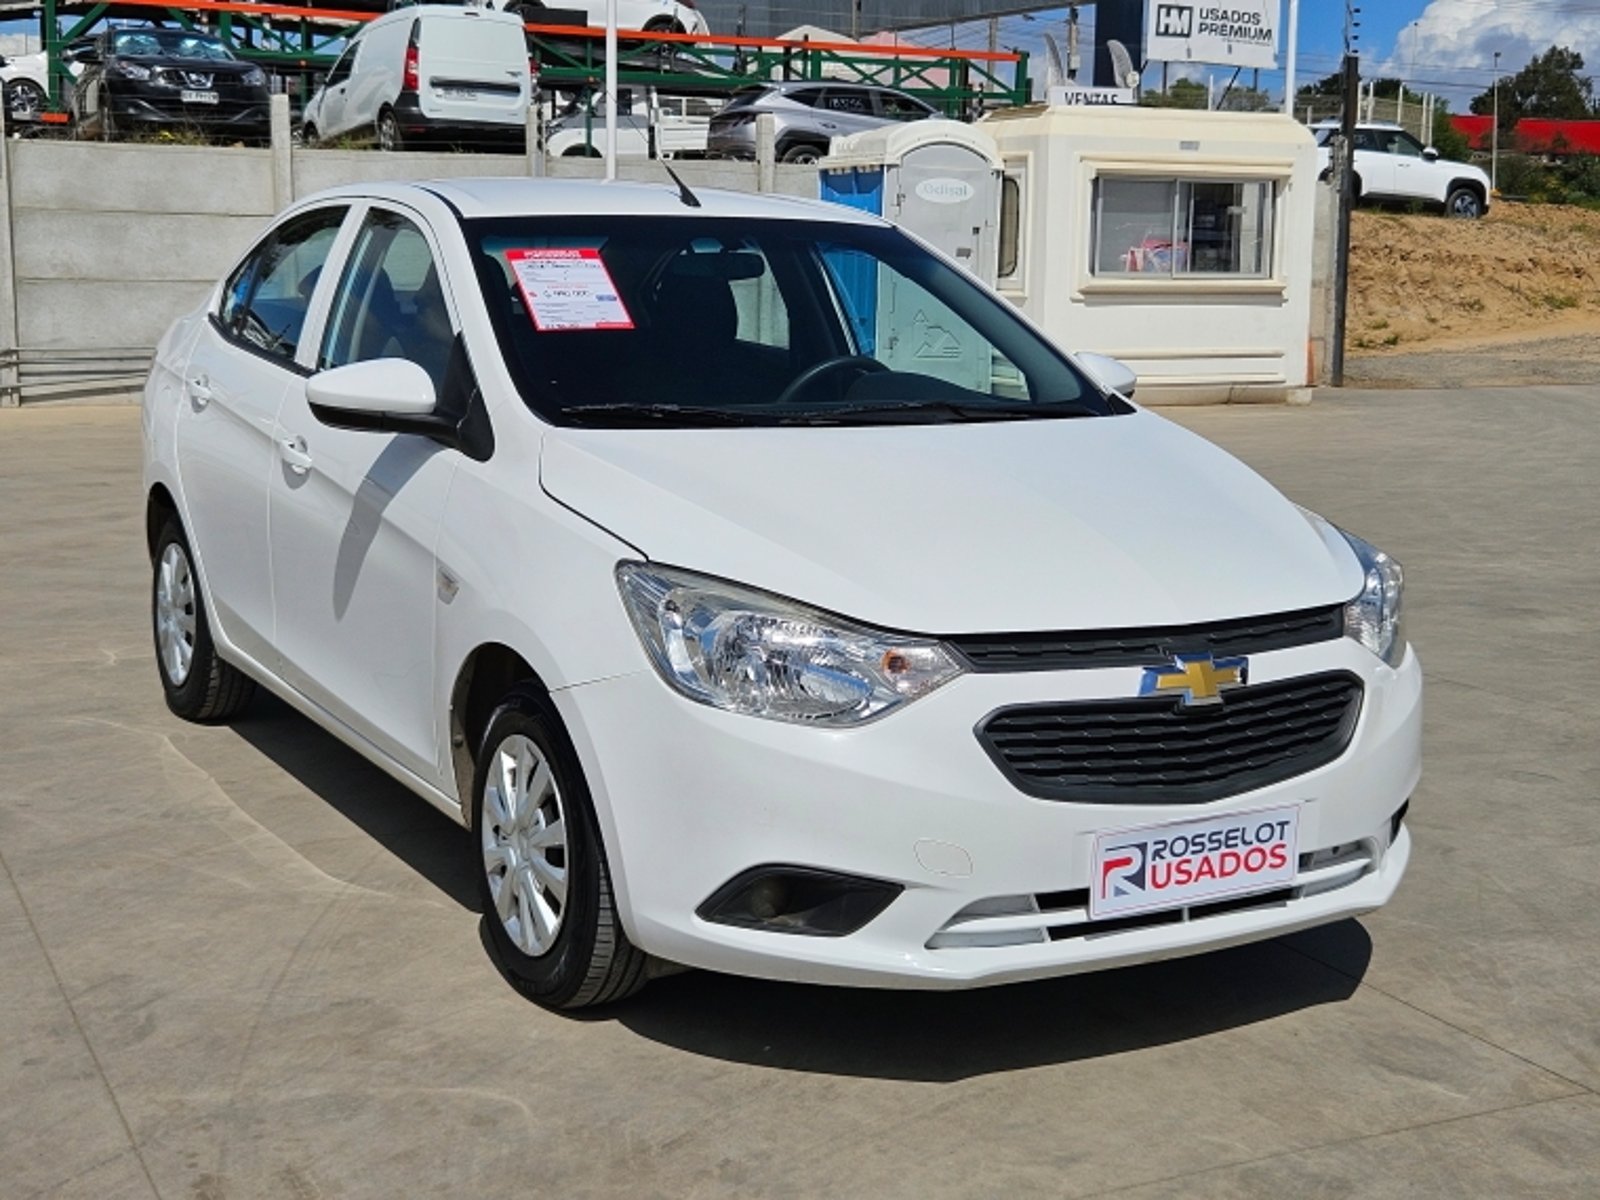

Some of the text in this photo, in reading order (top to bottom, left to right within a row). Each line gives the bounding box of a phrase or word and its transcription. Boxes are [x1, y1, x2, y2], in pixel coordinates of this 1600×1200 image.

[1158, 7, 1191, 35] HM
[1199, 8, 1261, 26] USADOS
[1198, 22, 1272, 41] PREMIUM
[1151, 820, 1291, 861] ROSSELOT
[1151, 843, 1287, 889] USADOS
